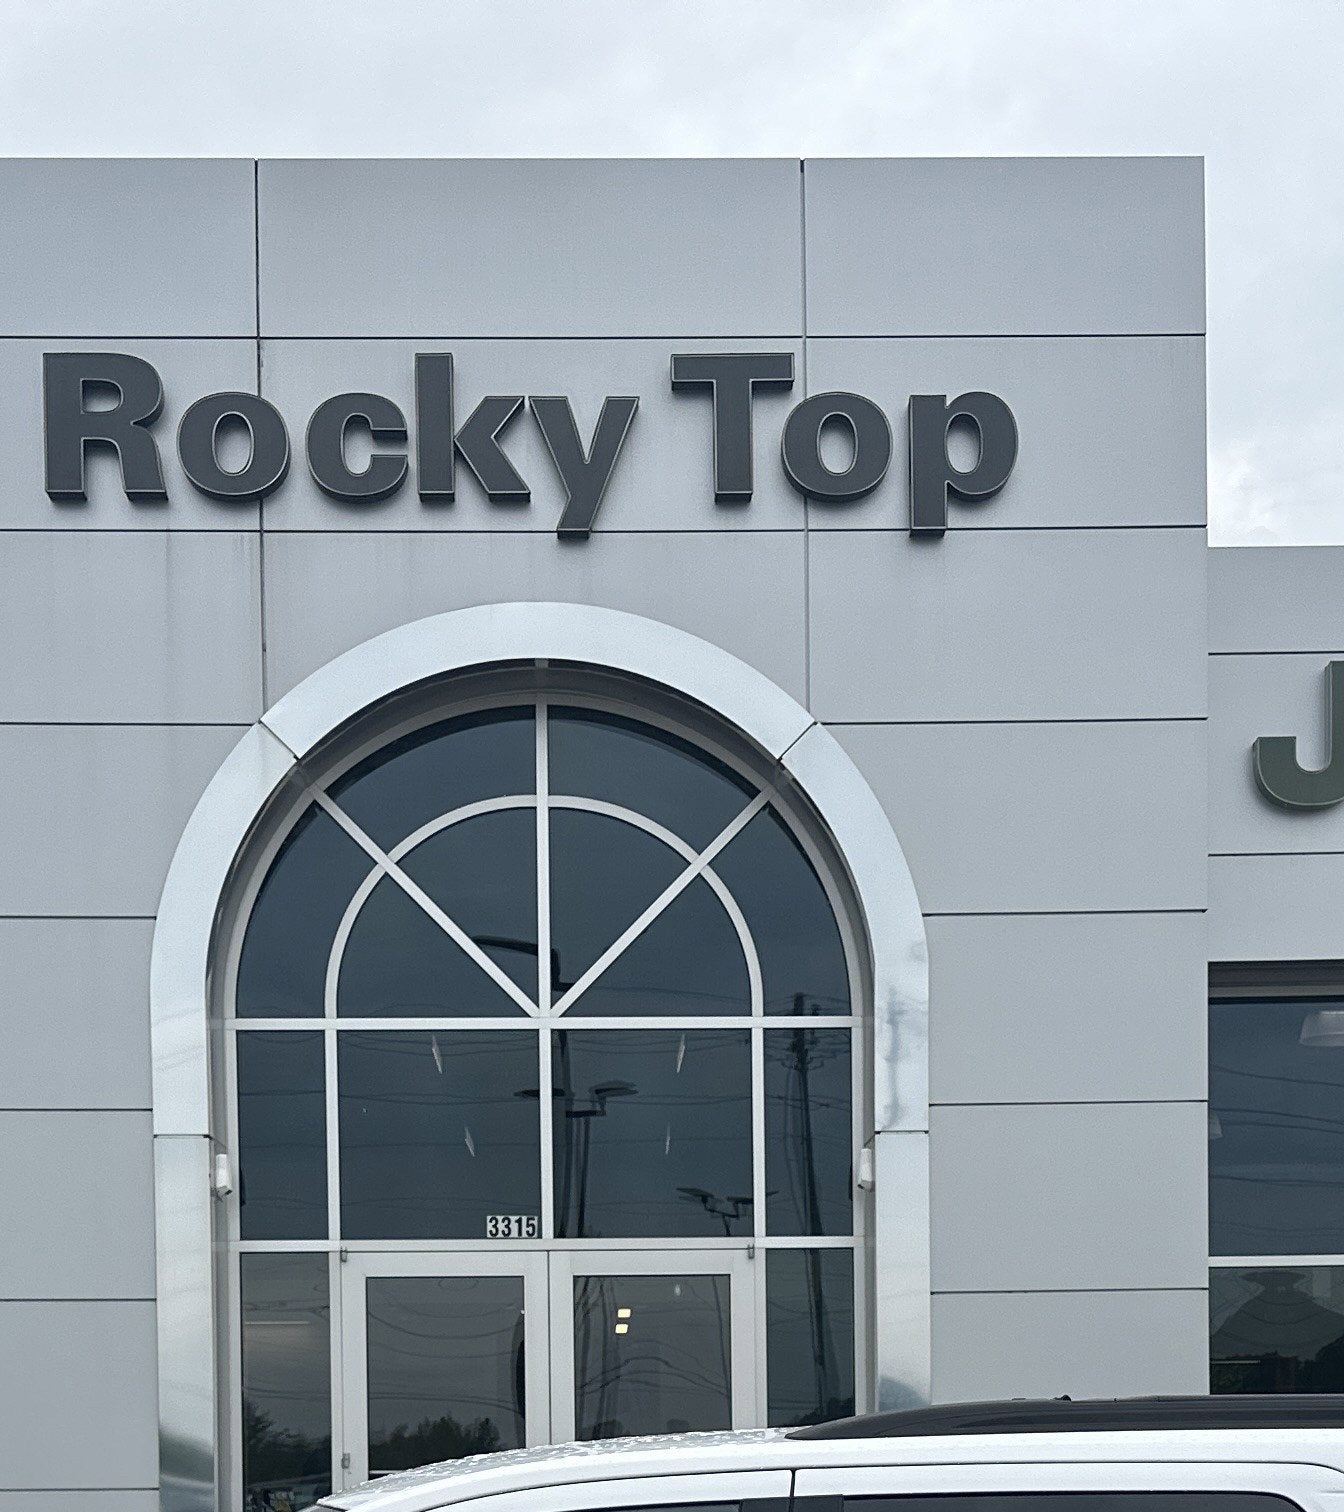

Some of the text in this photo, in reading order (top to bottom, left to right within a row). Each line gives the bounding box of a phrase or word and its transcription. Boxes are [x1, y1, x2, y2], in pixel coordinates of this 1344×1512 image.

[42, 352, 1020, 540] Rocky Top
[488, 1216, 536, 1237] 3315
